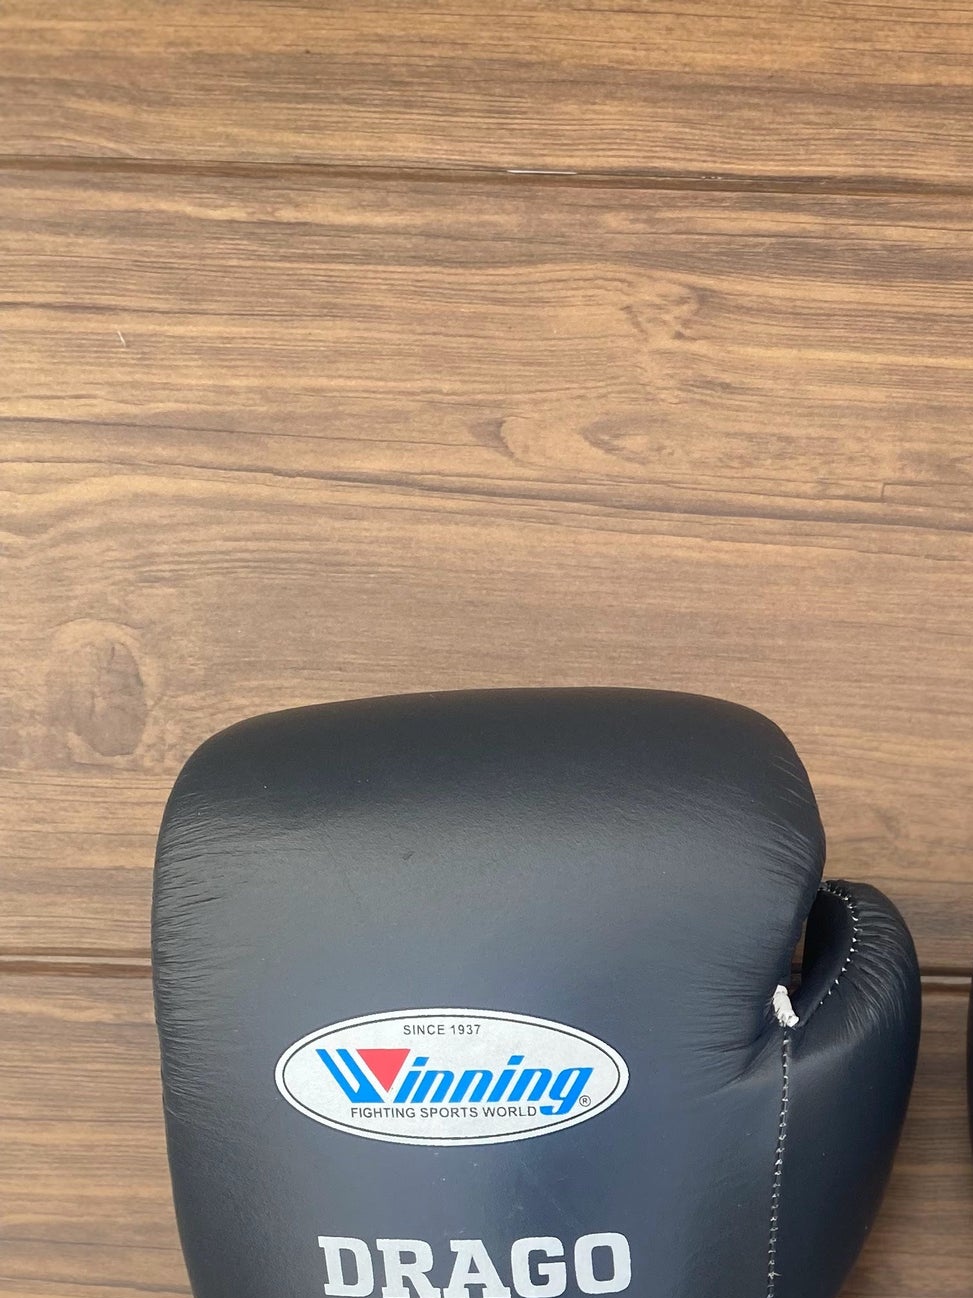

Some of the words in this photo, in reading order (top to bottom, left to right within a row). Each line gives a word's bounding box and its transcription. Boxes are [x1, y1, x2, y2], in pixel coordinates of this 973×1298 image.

[403, 1024, 446, 1036] SINCE
[450, 1024, 481, 1035] 1937
[315, 1048, 594, 1116] Winning
[351, 1106, 416, 1119] FIGHTING
[420, 1106, 478, 1119] SPORTS
[483, 1105, 537, 1118] WORLD
